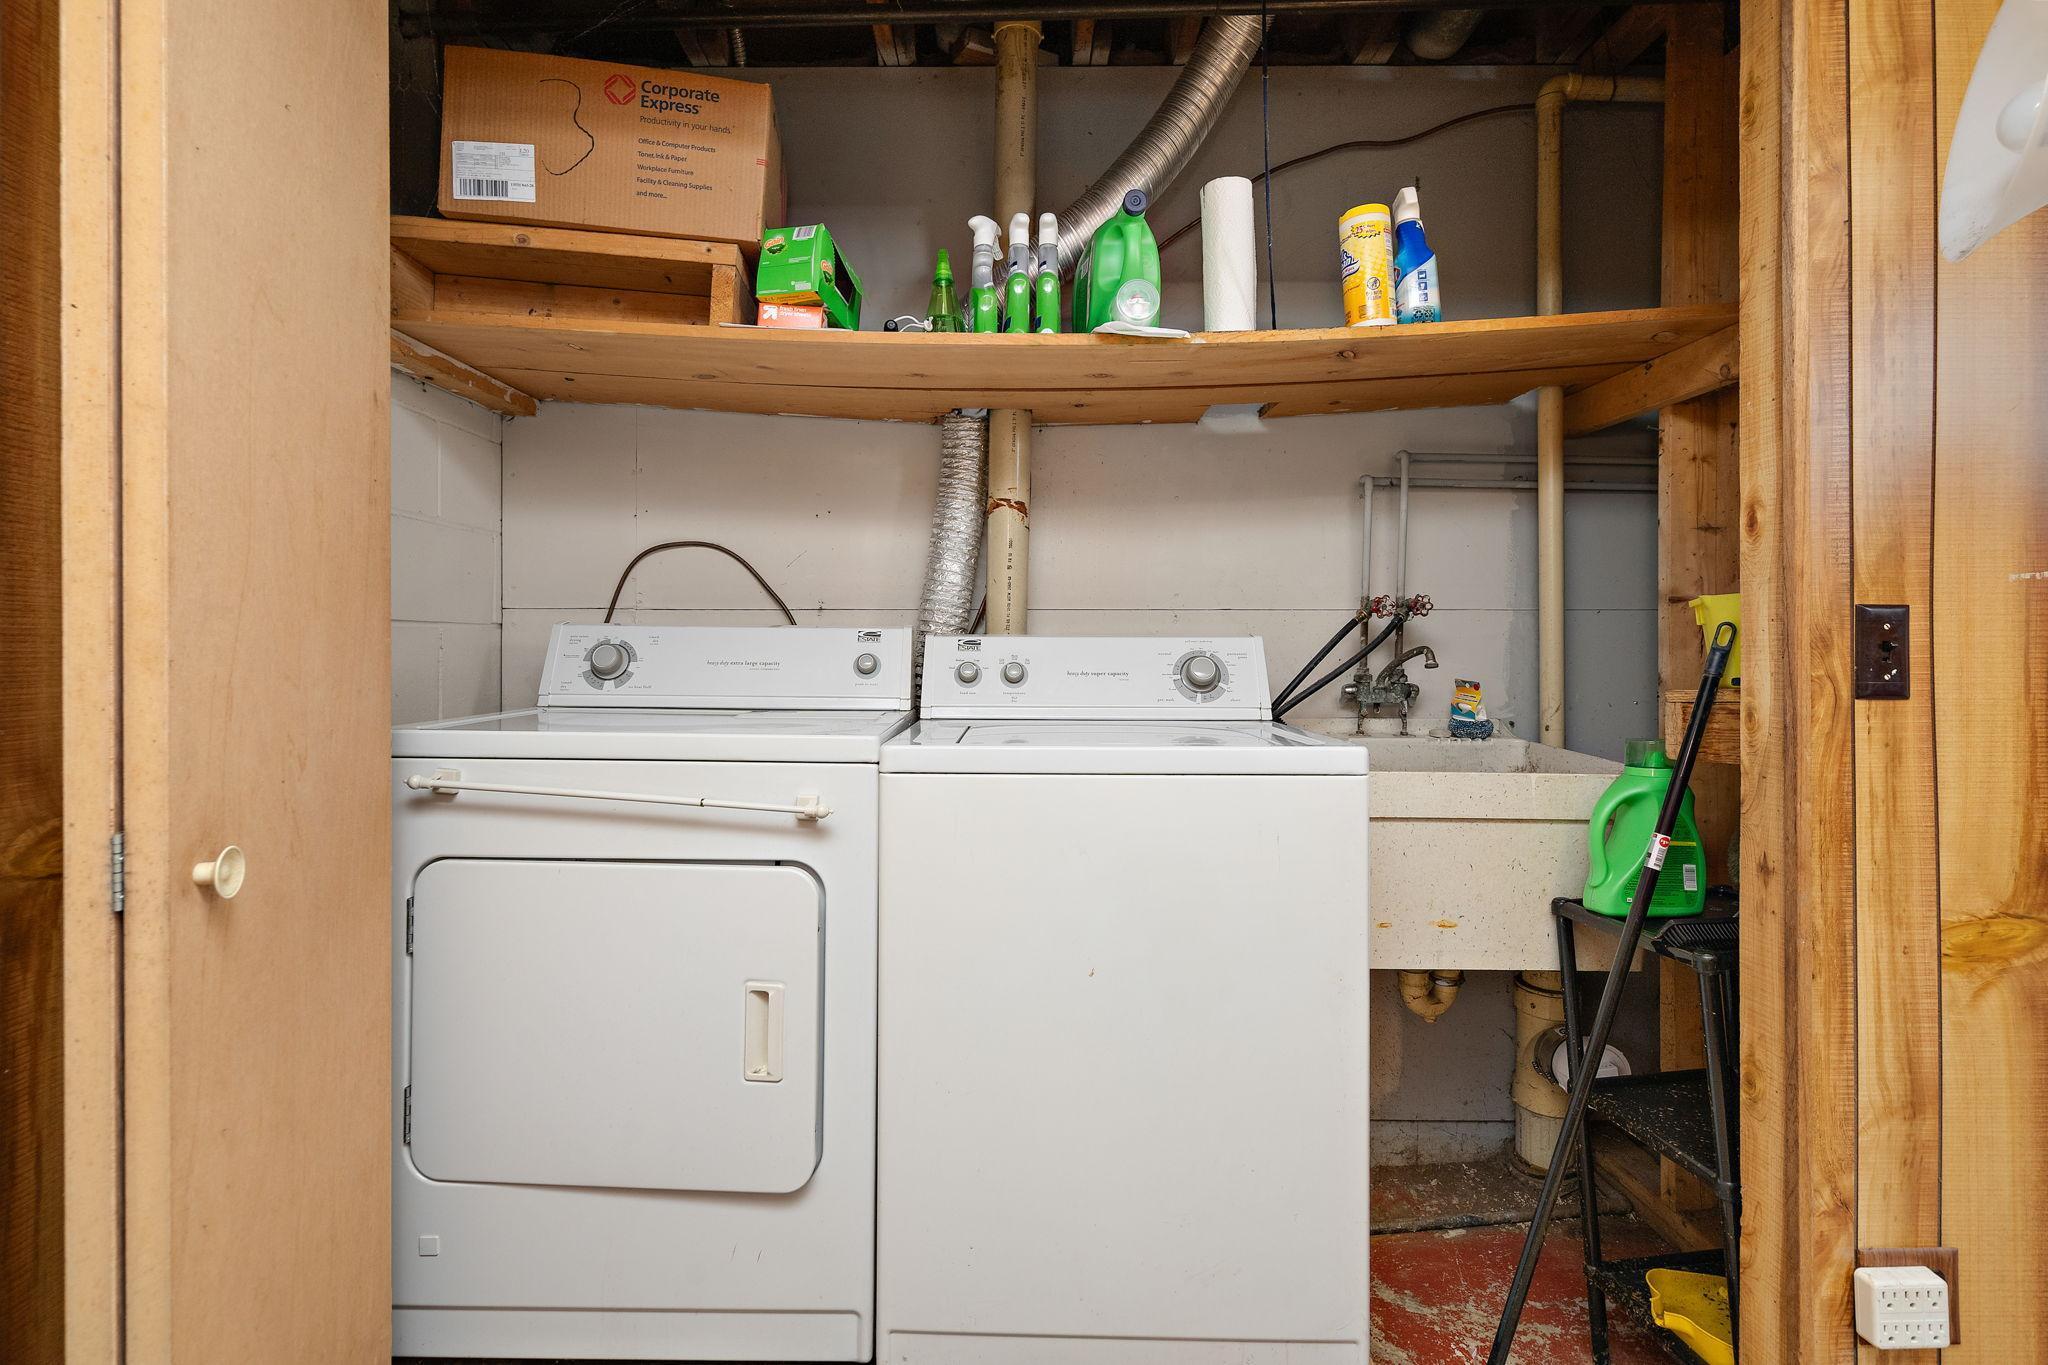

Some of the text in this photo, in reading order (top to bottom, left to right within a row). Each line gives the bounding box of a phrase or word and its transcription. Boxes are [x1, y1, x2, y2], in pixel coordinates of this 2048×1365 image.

[641, 80, 720, 102] Corporate
[640, 95, 700, 114] Express
[640, 116, 681, 128] Productivity
[691, 123, 708, 131] your
[638, 138, 655, 146] Office
[662, 140, 690, 149] Computer
[691, 144, 716, 153] Products
[671, 154, 687, 162] Paper
[637, 163, 694, 175] Workplace Furniture
[636, 176, 656, 185] Facility
[663, 180, 688, 189] Cleaning
[688, 182, 713, 191] Supplies
